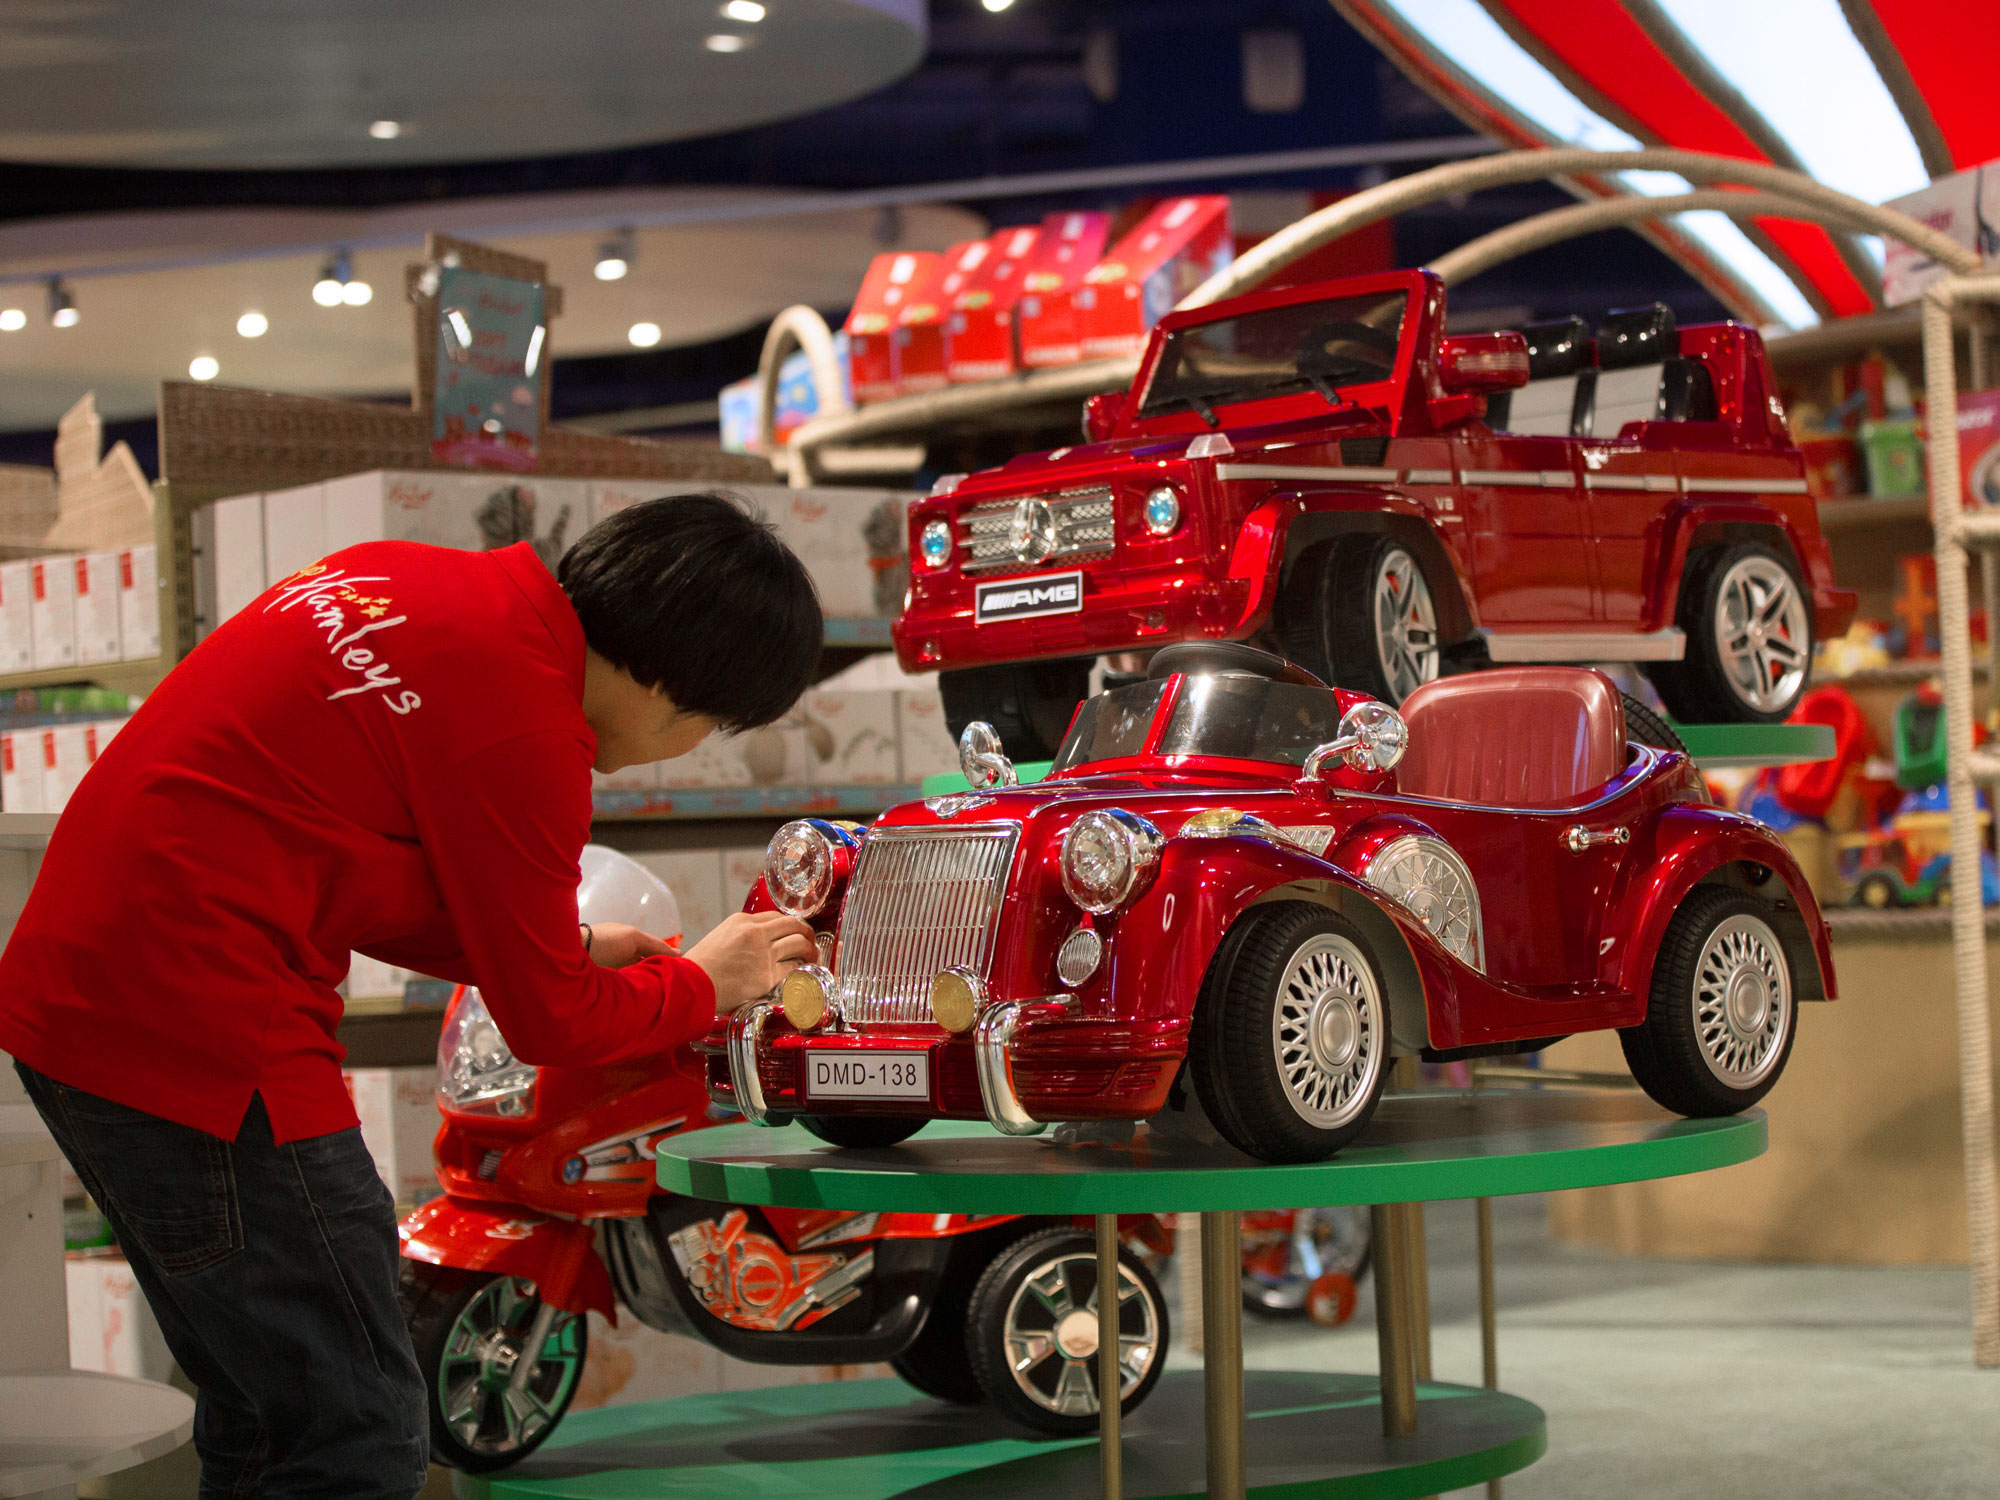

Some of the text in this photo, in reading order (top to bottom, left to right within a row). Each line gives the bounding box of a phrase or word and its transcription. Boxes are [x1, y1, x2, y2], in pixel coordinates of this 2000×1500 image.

[1010, 583, 1077, 608] AMG
[262, 569, 422, 715] Hamleys
[817, 1062, 917, 1086] DMD-138
